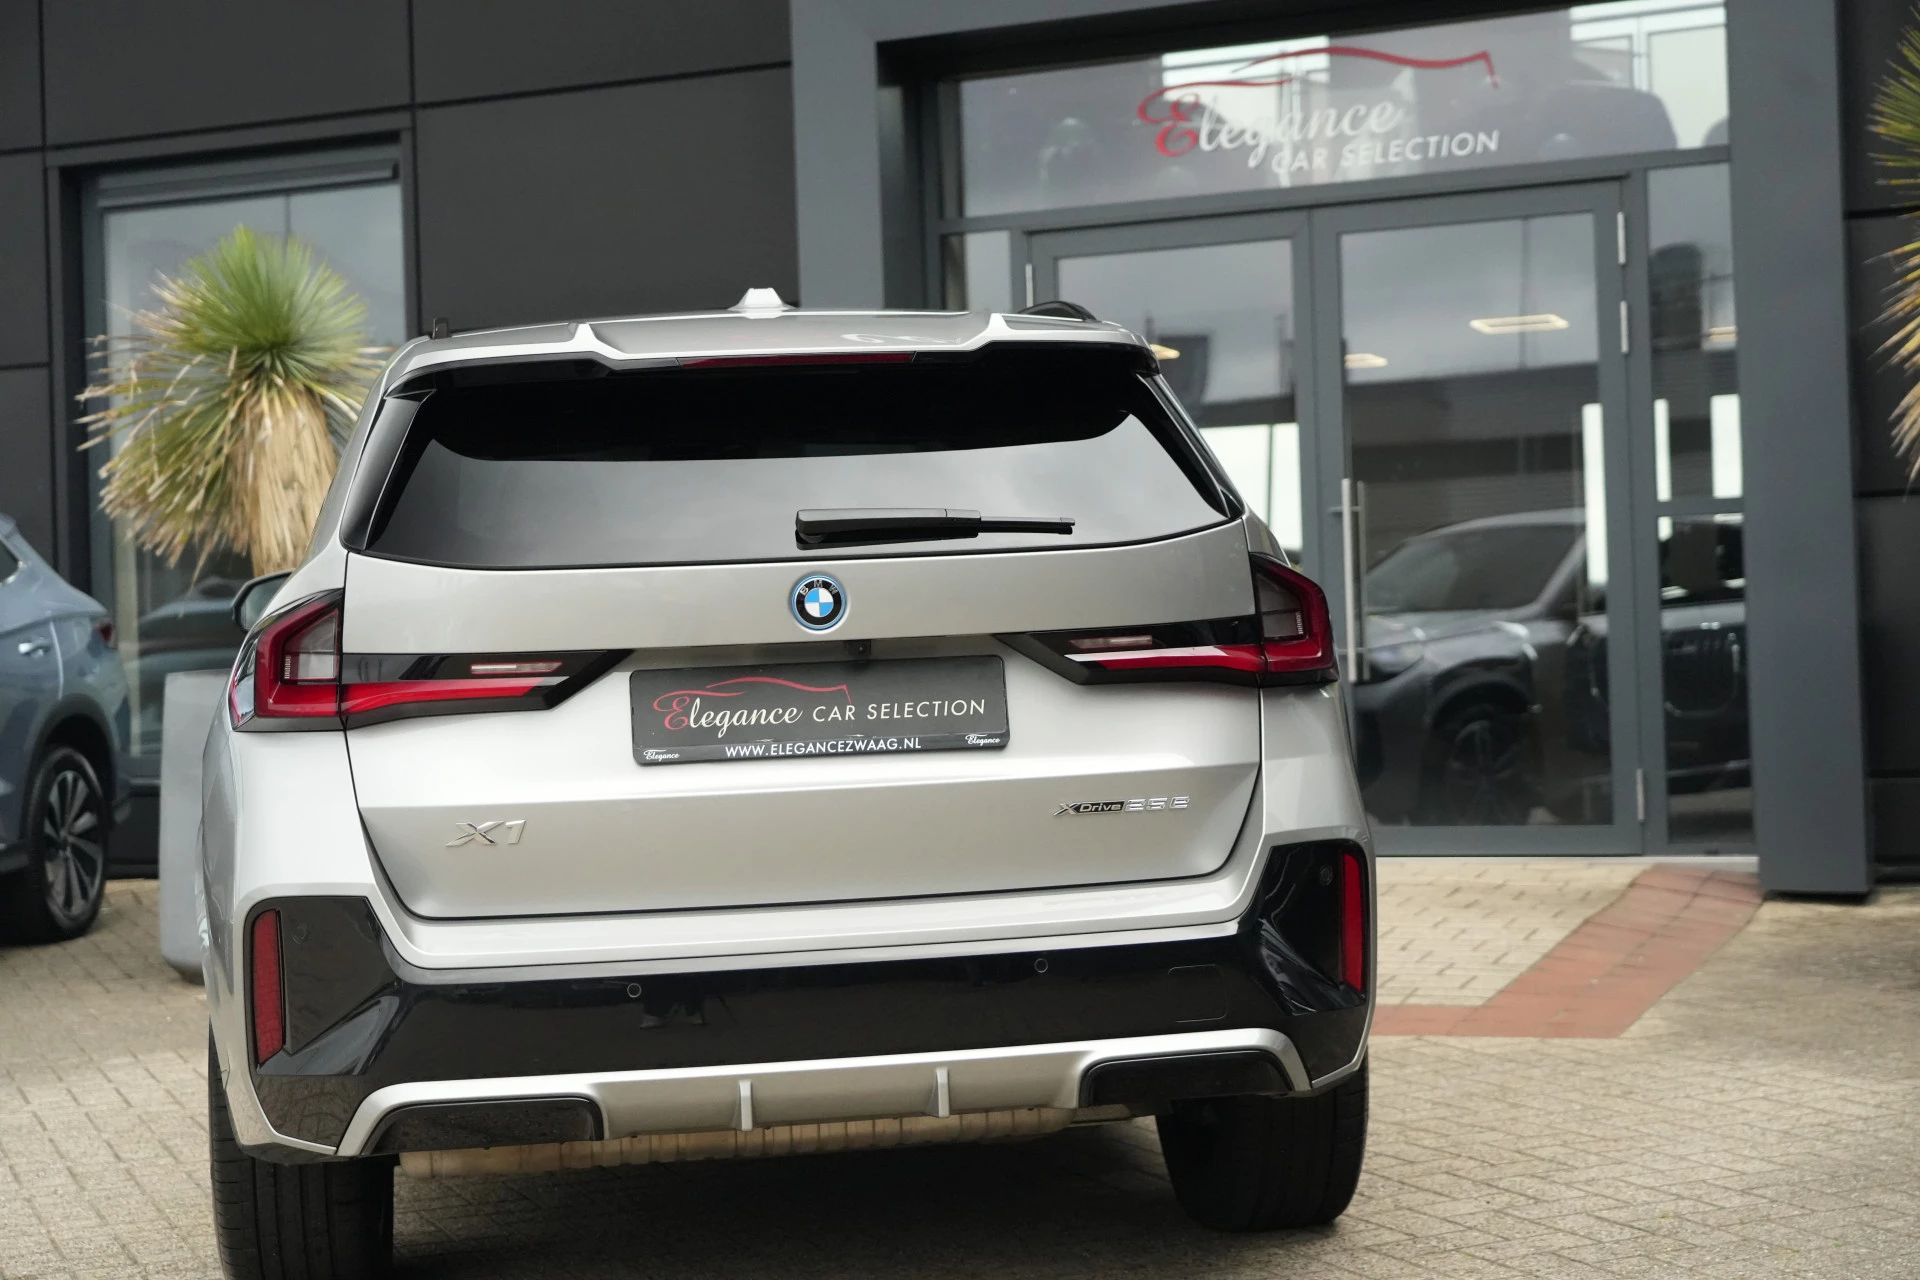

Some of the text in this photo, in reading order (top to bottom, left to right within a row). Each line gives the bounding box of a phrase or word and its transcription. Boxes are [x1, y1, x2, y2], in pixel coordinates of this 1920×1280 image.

[1137, 82, 1400, 169] Elegance
[1270, 129, 1500, 175] CAR SELECTION
[799, 579, 839, 597] BMW
[653, 690, 986, 738] Elegance CAR SELECTION
[725, 737, 922, 758] WWW.ELEGANCEZWAAG.NL
[965, 733, 1001, 747] Elegance
[643, 749, 680, 762] Elegance
[445, 819, 527, 848] X1
